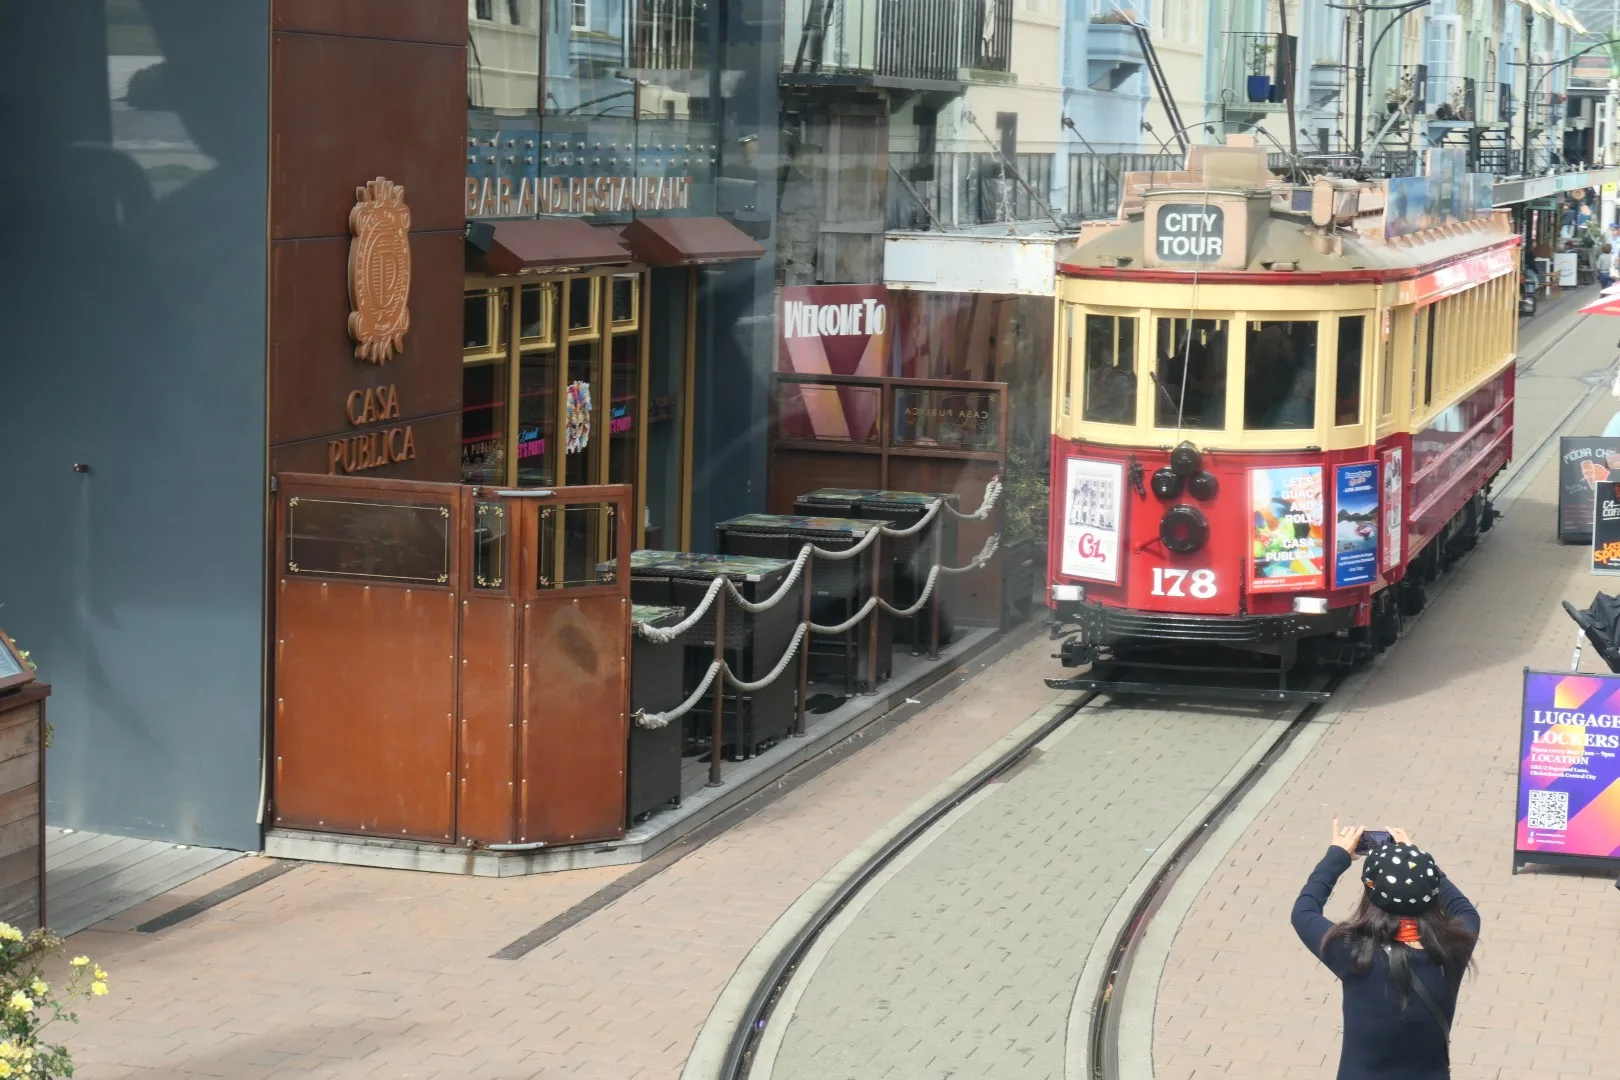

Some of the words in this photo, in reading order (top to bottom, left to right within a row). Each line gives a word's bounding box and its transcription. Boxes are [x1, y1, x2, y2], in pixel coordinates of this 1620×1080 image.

[465, 177, 513, 216] BAR
[517, 177, 562, 214] AND
[568, 176, 694, 213] RESTAURANT
[1164, 212, 1217, 232] CITY
[1158, 236, 1223, 256] TOUR
[784, 300, 862, 338] WELCOME
[862, 298, 886, 336] TO
[346, 383, 400, 425] CASA
[328, 425, 417, 475] PUBLICA
[1563, 447, 1592, 464] MOCHA
[1282, 488, 1314, 499] GUAC
[1289, 500, 1315, 511] AND
[1602, 500, 1615, 509] C4
[1285, 513, 1314, 524] ROLL
[1282, 538, 1316, 548] CASA
[1265, 550, 1315, 561] PUBLICA
[1151, 567, 1218, 599] 178
[1533, 710, 1620, 728] LUGGAGE
[1531, 730, 1619, 748] LOCKERS
[1530, 753, 1589, 765] LOCATION
[1600, 751, 1616, 759] 9pm
